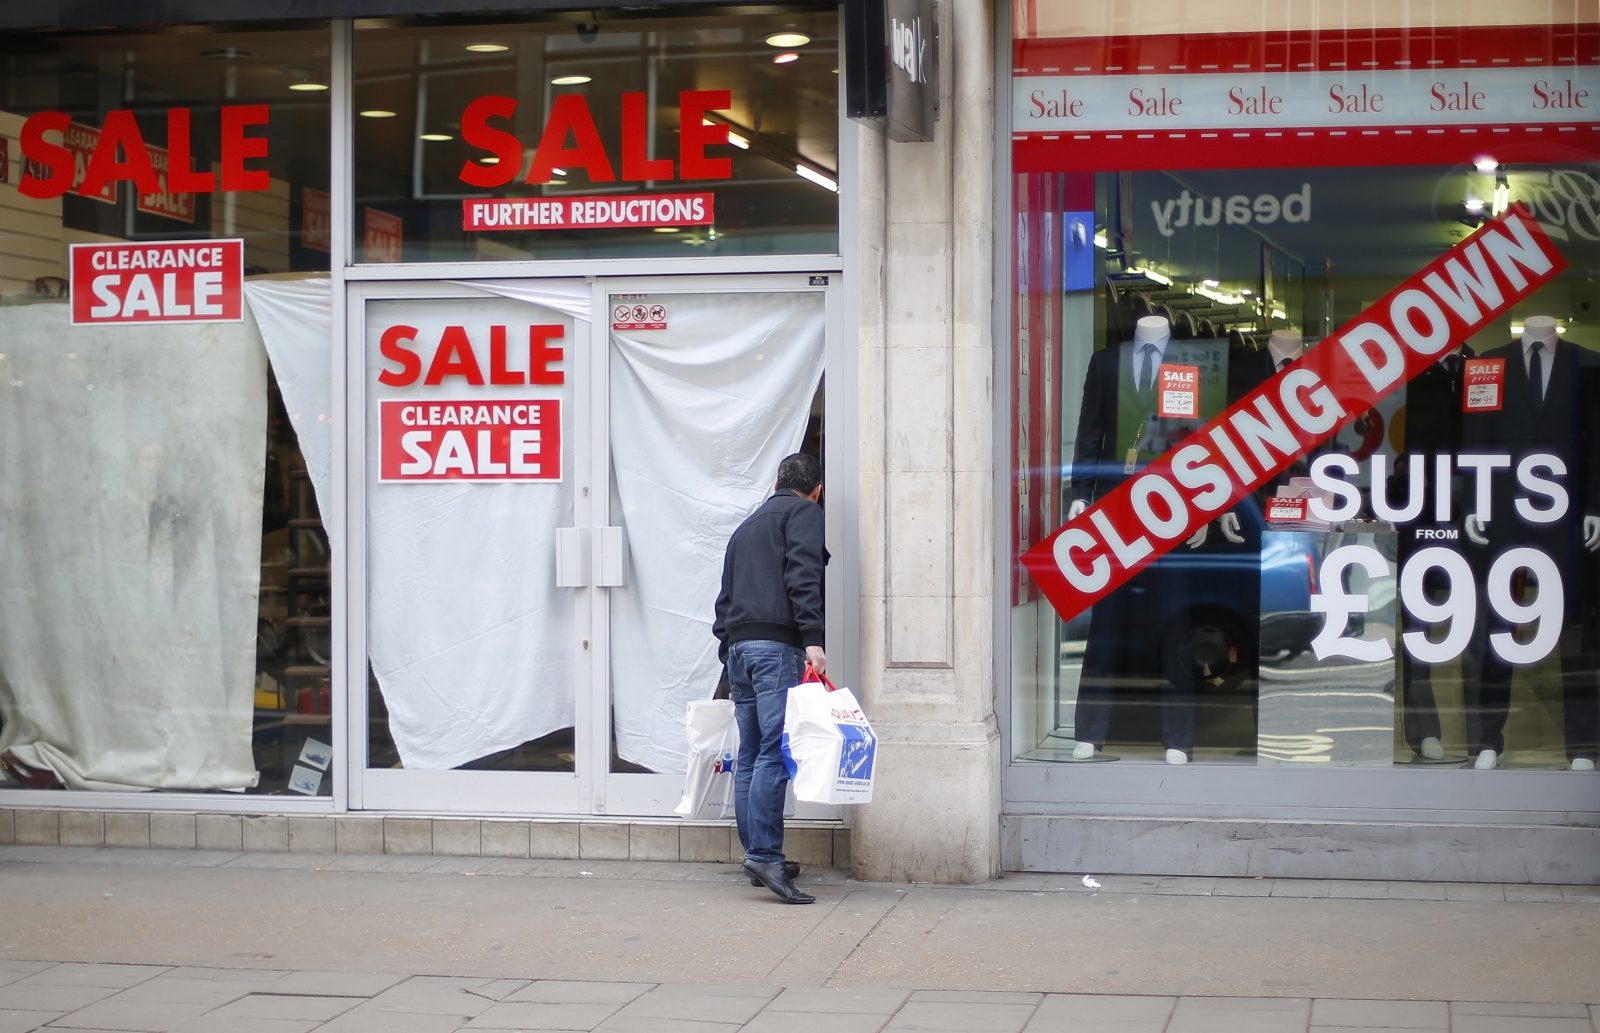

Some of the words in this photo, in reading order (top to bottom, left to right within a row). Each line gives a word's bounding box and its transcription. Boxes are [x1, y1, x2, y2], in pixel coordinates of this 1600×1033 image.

[1029, 89, 1084, 119] Sale
[1128, 87, 1183, 117] Sale
[1228, 86, 1283, 116] Sale
[1328, 84, 1384, 114] Sale
[1430, 82, 1486, 112] Sale
[1532, 79, 1589, 110] Sale
[17, 104, 270, 200] SALE
[458, 89, 732, 188] SALE
[473, 201, 564, 227] FURTHER
[571, 197, 705, 226] REDUCTIONS
[92, 247, 223, 271] CLEARANCE
[91, 271, 223, 318] SALE
[1343, 213, 1554, 393] DOWN
[378, 324, 565, 387] SALE
[1469, 364, 1500, 375] SALE
[1163, 371, 1194, 382] SALE
[1166, 381, 1192, 389] price
[1471, 374, 1497, 383] price
[401, 404, 541, 426] CLEARANCE
[400, 429, 541, 475] SALE
[1053, 368, 1348, 594] CLOSING
[1307, 453, 1569, 524] SUITS
[1415, 529, 1459, 540] FROM
[1310, 545, 1565, 664] £99
